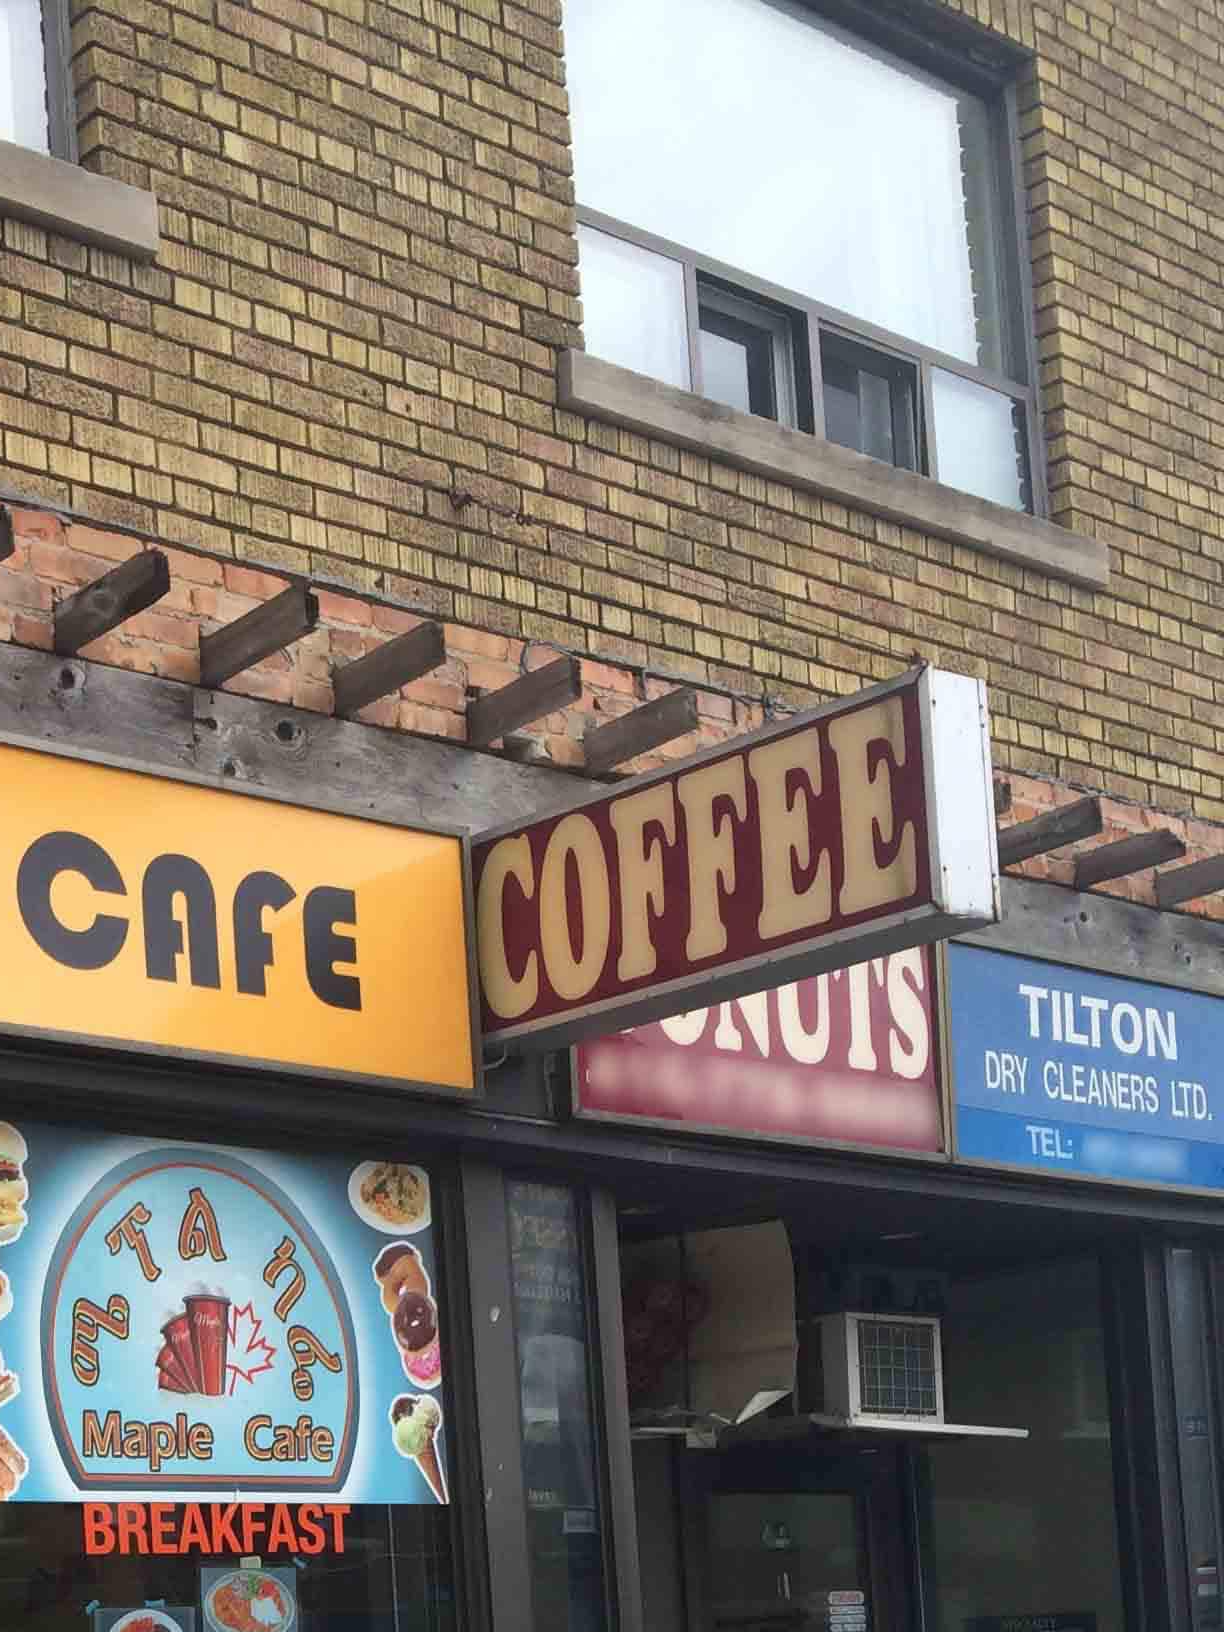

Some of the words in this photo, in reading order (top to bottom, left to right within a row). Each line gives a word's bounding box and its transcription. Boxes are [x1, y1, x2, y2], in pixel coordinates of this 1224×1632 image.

[477, 696, 918, 1019] COFFEE
[15, 829, 363, 1012] CAFE
[1018, 983, 1178, 1061] TILTON
[984, 1050, 1029, 1095] DRY
[1042, 1060, 1161, 1114] CLEANERS
[1170, 1079, 1214, 1121] LTD.
[1026, 1125, 1074, 1160] TEL:
[81, 1408, 215, 1473] Maple
[243, 1413, 336, 1462] Cafe
[81, 1502, 352, 1556] BREAKFAST
